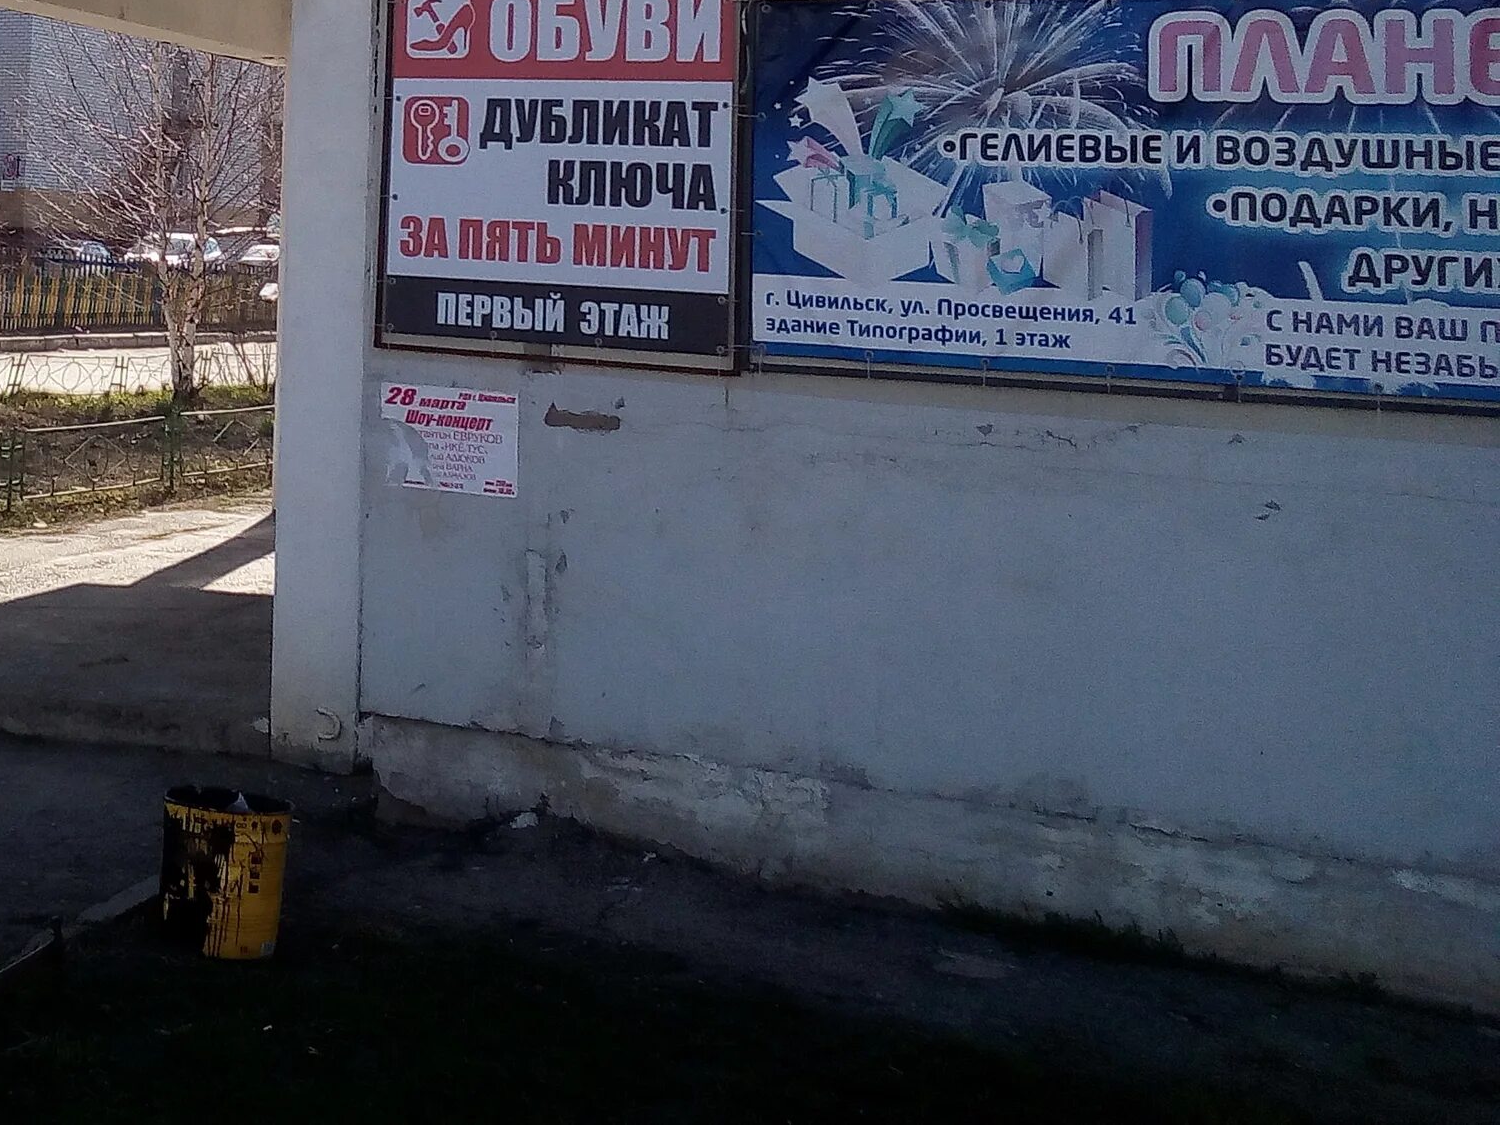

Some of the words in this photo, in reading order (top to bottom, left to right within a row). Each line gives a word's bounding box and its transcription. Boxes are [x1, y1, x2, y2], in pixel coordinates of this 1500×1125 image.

[477, 97, 719, 150] ДУБЛИКАТ
[1175, 133, 1202, 166] И
[1215, 133, 1500, 173] ВОЗДУШНЫЕ
[546, 159, 718, 212] КЛЮЧА
[399, 215, 448, 259] ЗА
[457, 217, 562, 265] ПЯТЬ
[572, 223, 717, 273] МИНУТ
[436, 291, 566, 334] ПЕРВЫЙ
[579, 300, 670, 340] ЭТАЖ
[765, 291, 781, 307] г.
[786, 289, 895, 316] Цивильск,
[900, 298, 931, 318] ул.
[936, 298, 1101, 326] Просвещения,
[1107, 306, 1138, 326] 41
[1266, 309, 1284, 332] С
[1291, 310, 1384, 338] НАМИ
[1394, 316, 1469, 343] ВАШ
[765, 317, 841, 337] здание
[846, 319, 988, 347] Типографии,
[994, 327, 1008, 346] 1
[1014, 331, 1073, 350] этаж
[1264, 343, 1362, 372] БУДЕТ
[385, 386, 417, 407] 28
[418, 397, 467, 411] марта
[404, 409, 493, 432] Шоу-концерт
